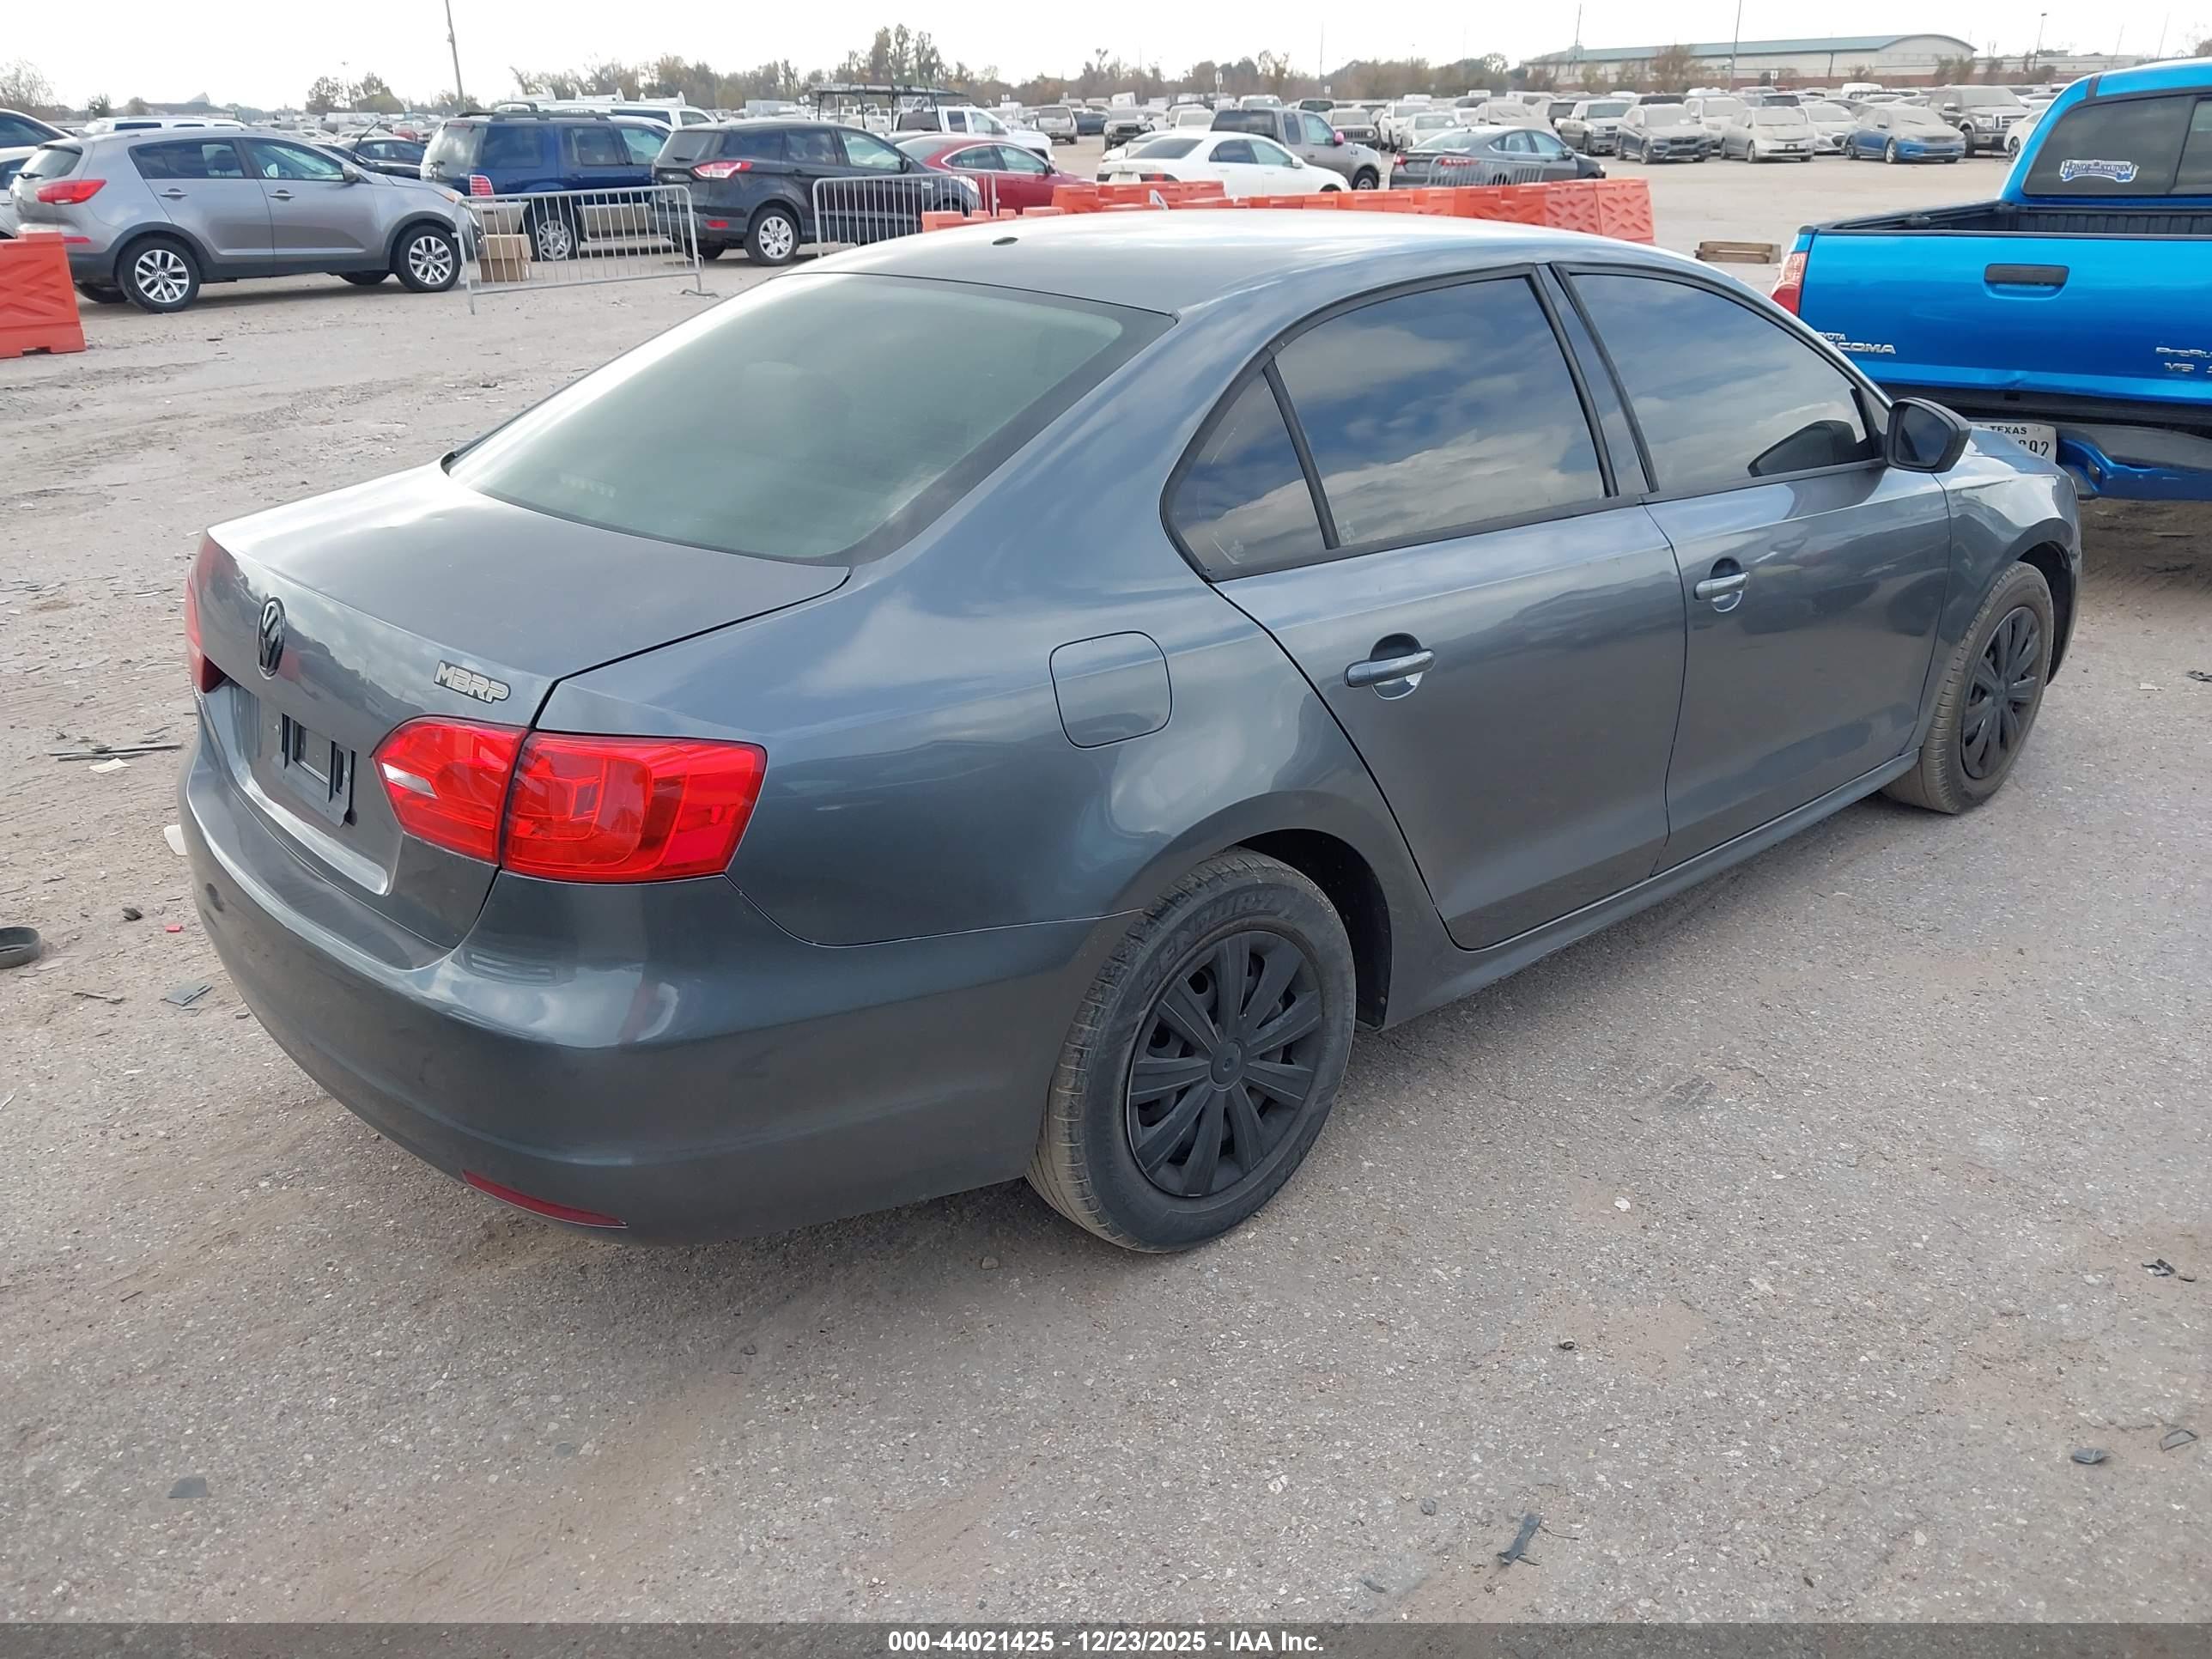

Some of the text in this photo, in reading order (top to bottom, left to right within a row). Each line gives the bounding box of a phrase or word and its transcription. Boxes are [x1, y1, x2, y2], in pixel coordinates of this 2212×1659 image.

[1817, 332, 1846, 341] YOTA
[1990, 426, 2027, 434] TEXAS
[434, 660, 511, 703] MBRP
